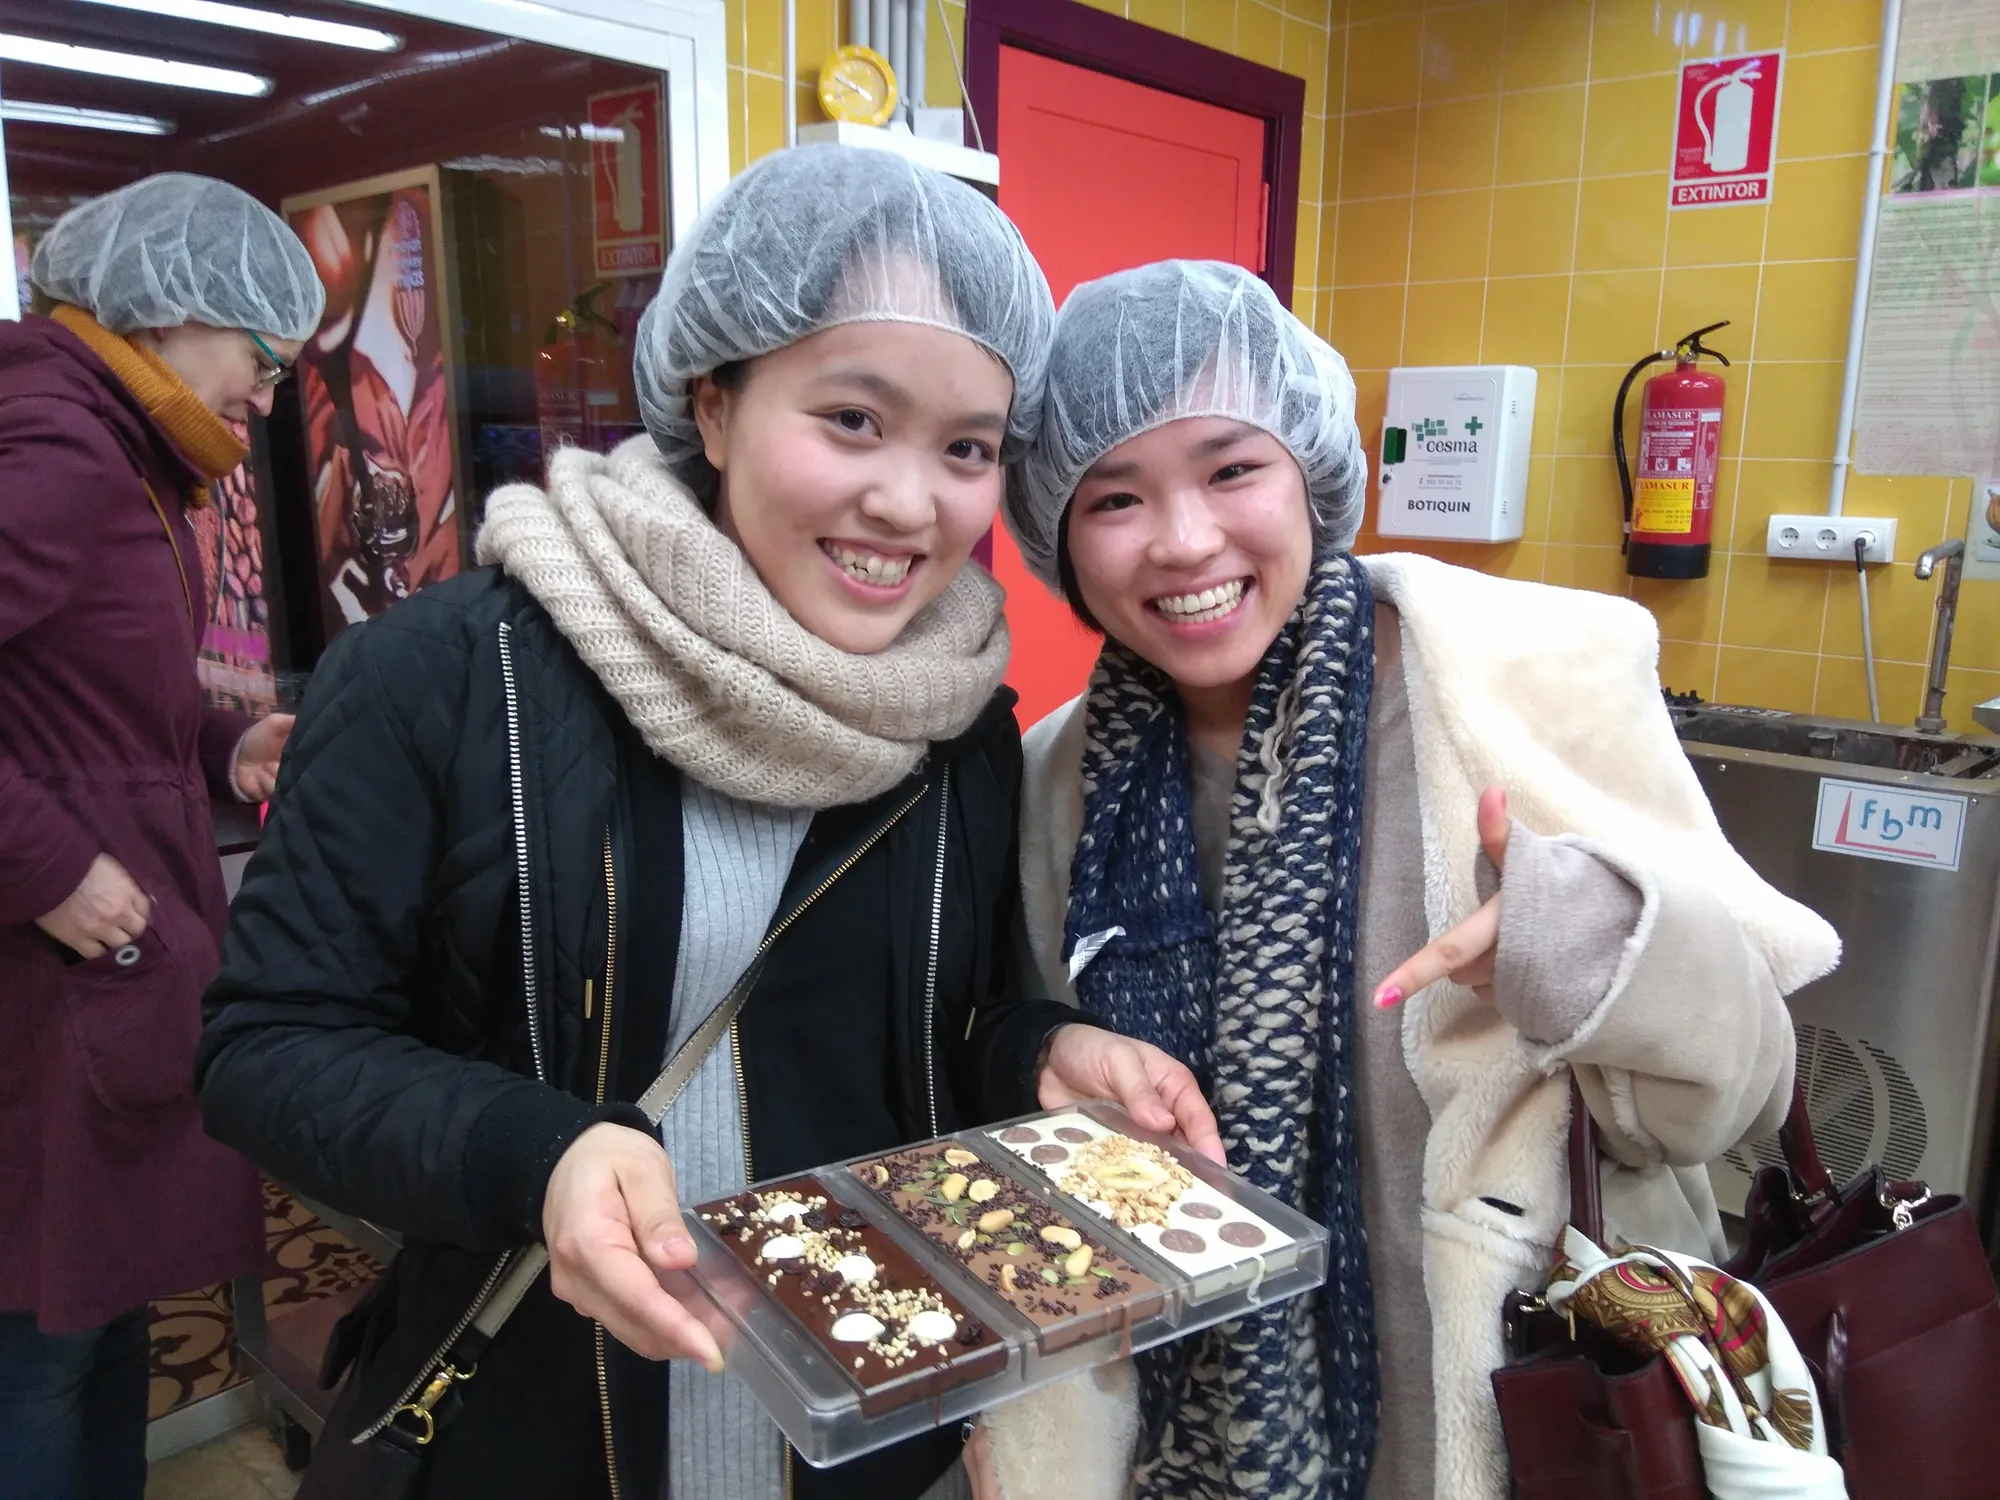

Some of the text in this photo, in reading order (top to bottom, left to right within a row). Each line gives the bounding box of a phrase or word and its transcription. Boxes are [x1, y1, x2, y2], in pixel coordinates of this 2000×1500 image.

[1678, 182, 1759, 202] EXTINTOR
[1426, 440, 1478, 453] cesma
[1408, 500, 1471, 513] BOTIQUIN
[1860, 799, 1942, 841] fbm
